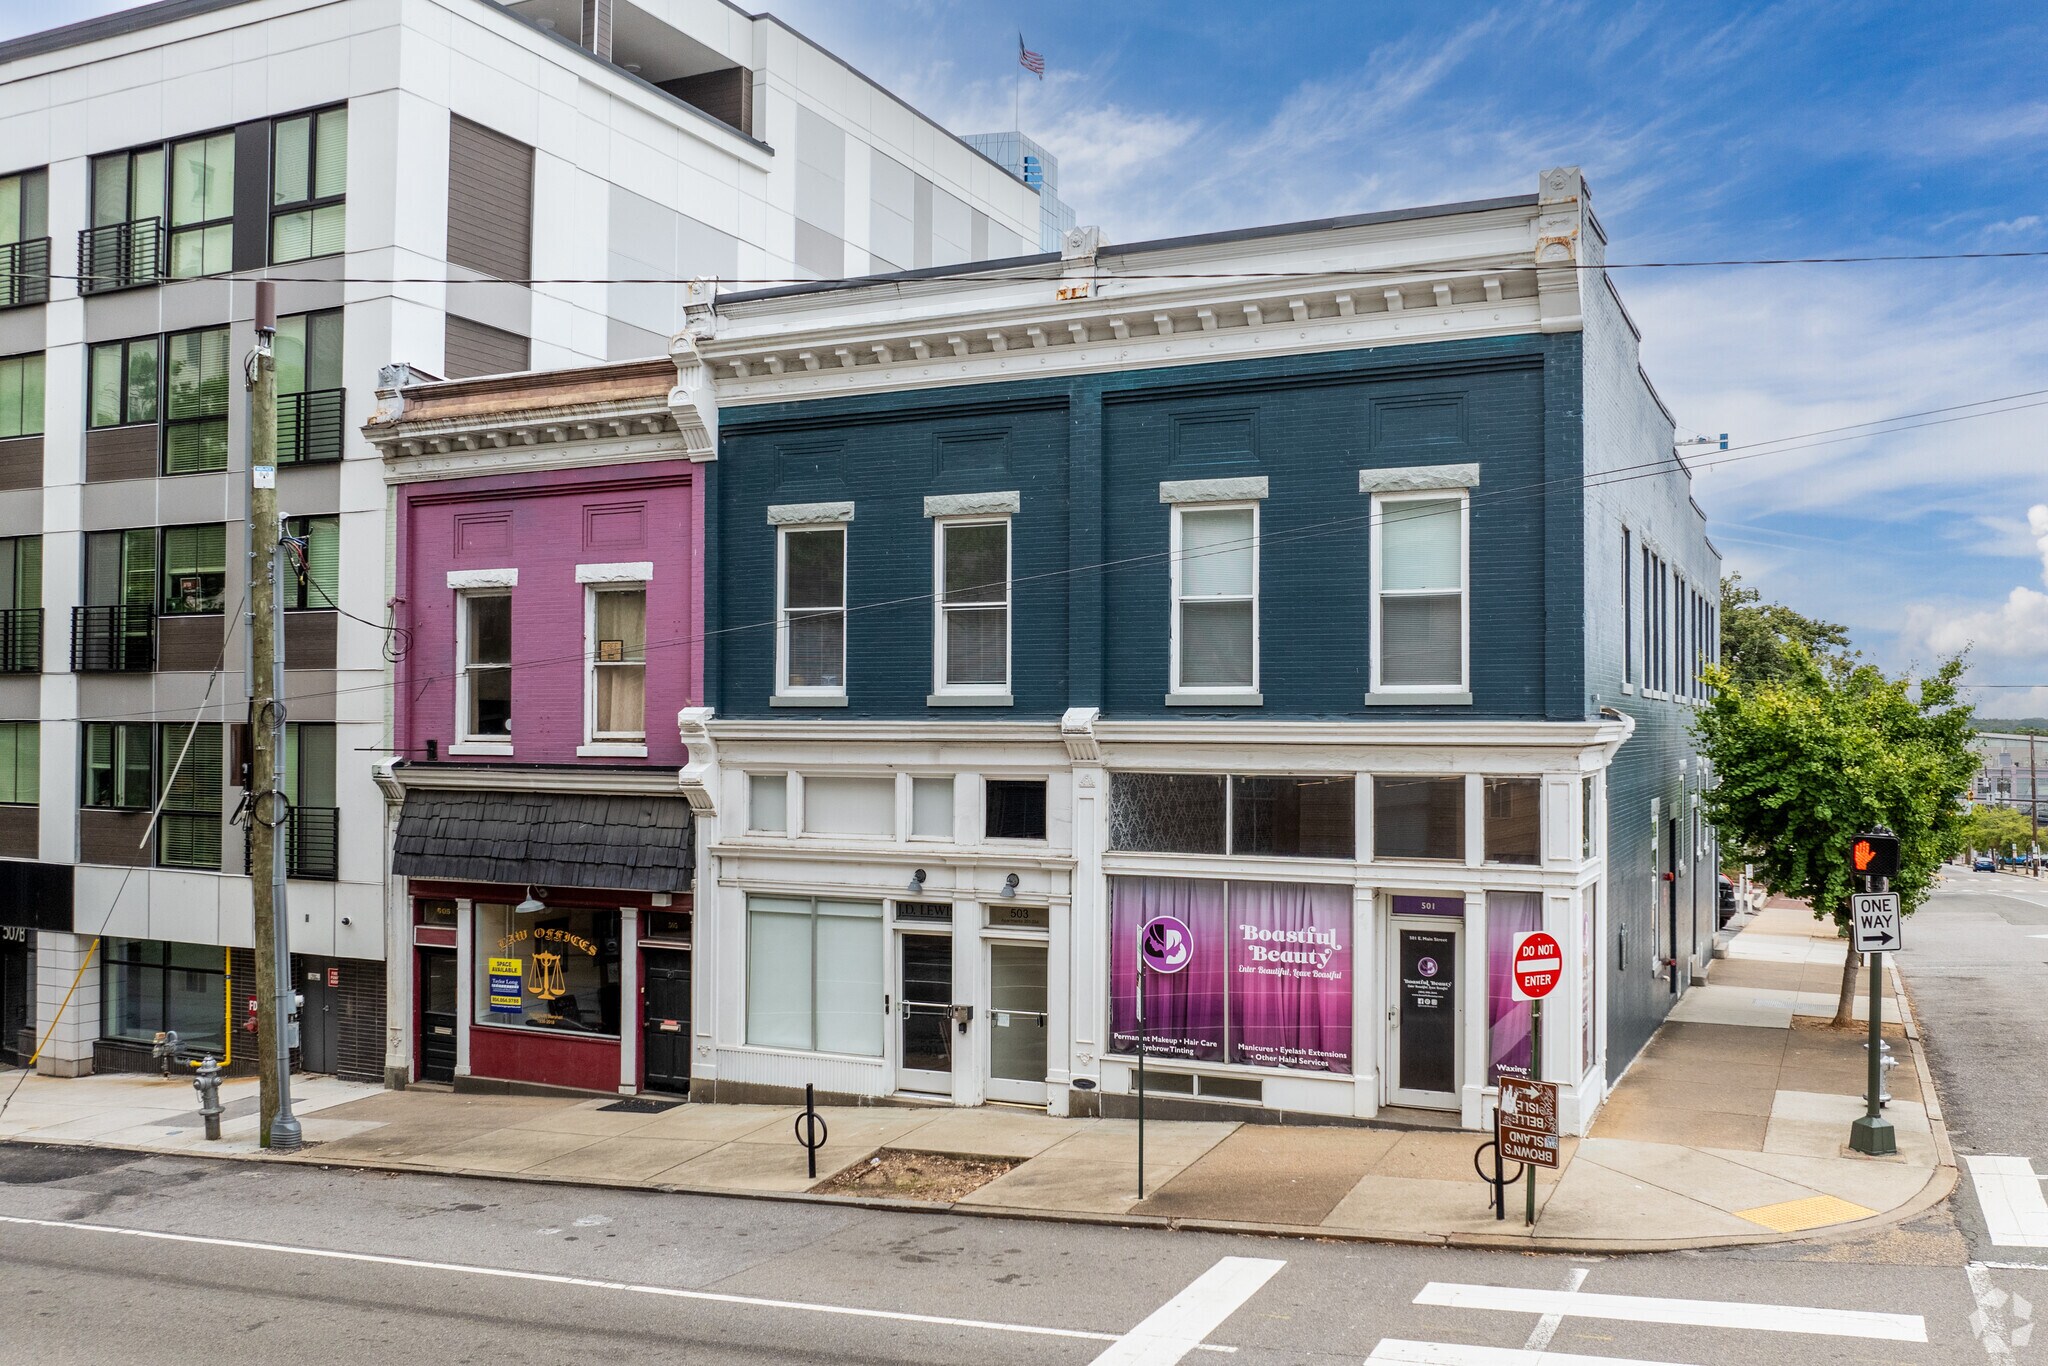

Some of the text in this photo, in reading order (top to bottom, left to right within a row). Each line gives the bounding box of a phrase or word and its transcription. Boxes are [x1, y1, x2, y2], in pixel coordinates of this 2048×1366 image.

[1421, 902, 1435, 910] 501
[1861, 899, 1892, 913] ONE
[1010, 908, 1029, 919] 503
[1861, 915, 1893, 929] WAY
[533, 927, 598, 956] OFFICES
[1239, 924, 1342, 951] Boastful
[1248, 945, 1333, 969] Beauty
[1522, 944, 1554, 957] DO NOT
[491, 966, 518, 974] AVAILABLE
[1238, 964, 1256, 973] Enter
[1292, 968, 1312, 979] Leave
[1524, 974, 1552, 987] ENTER
[1113, 1032, 1218, 1047] Permannt Makeup Hair Care
[1169, 1045, 1194, 1056] Tinting
[1237, 1043, 1347, 1059] Manicures Eyelash Extensions
[1255, 1053, 1329, 1067] Other Halal Services
[1496, 1063, 1528, 1075] Waxing
[1516, 1100, 1539, 1114] ISLE
[1504, 1143, 1553, 1162] BROWN'S
